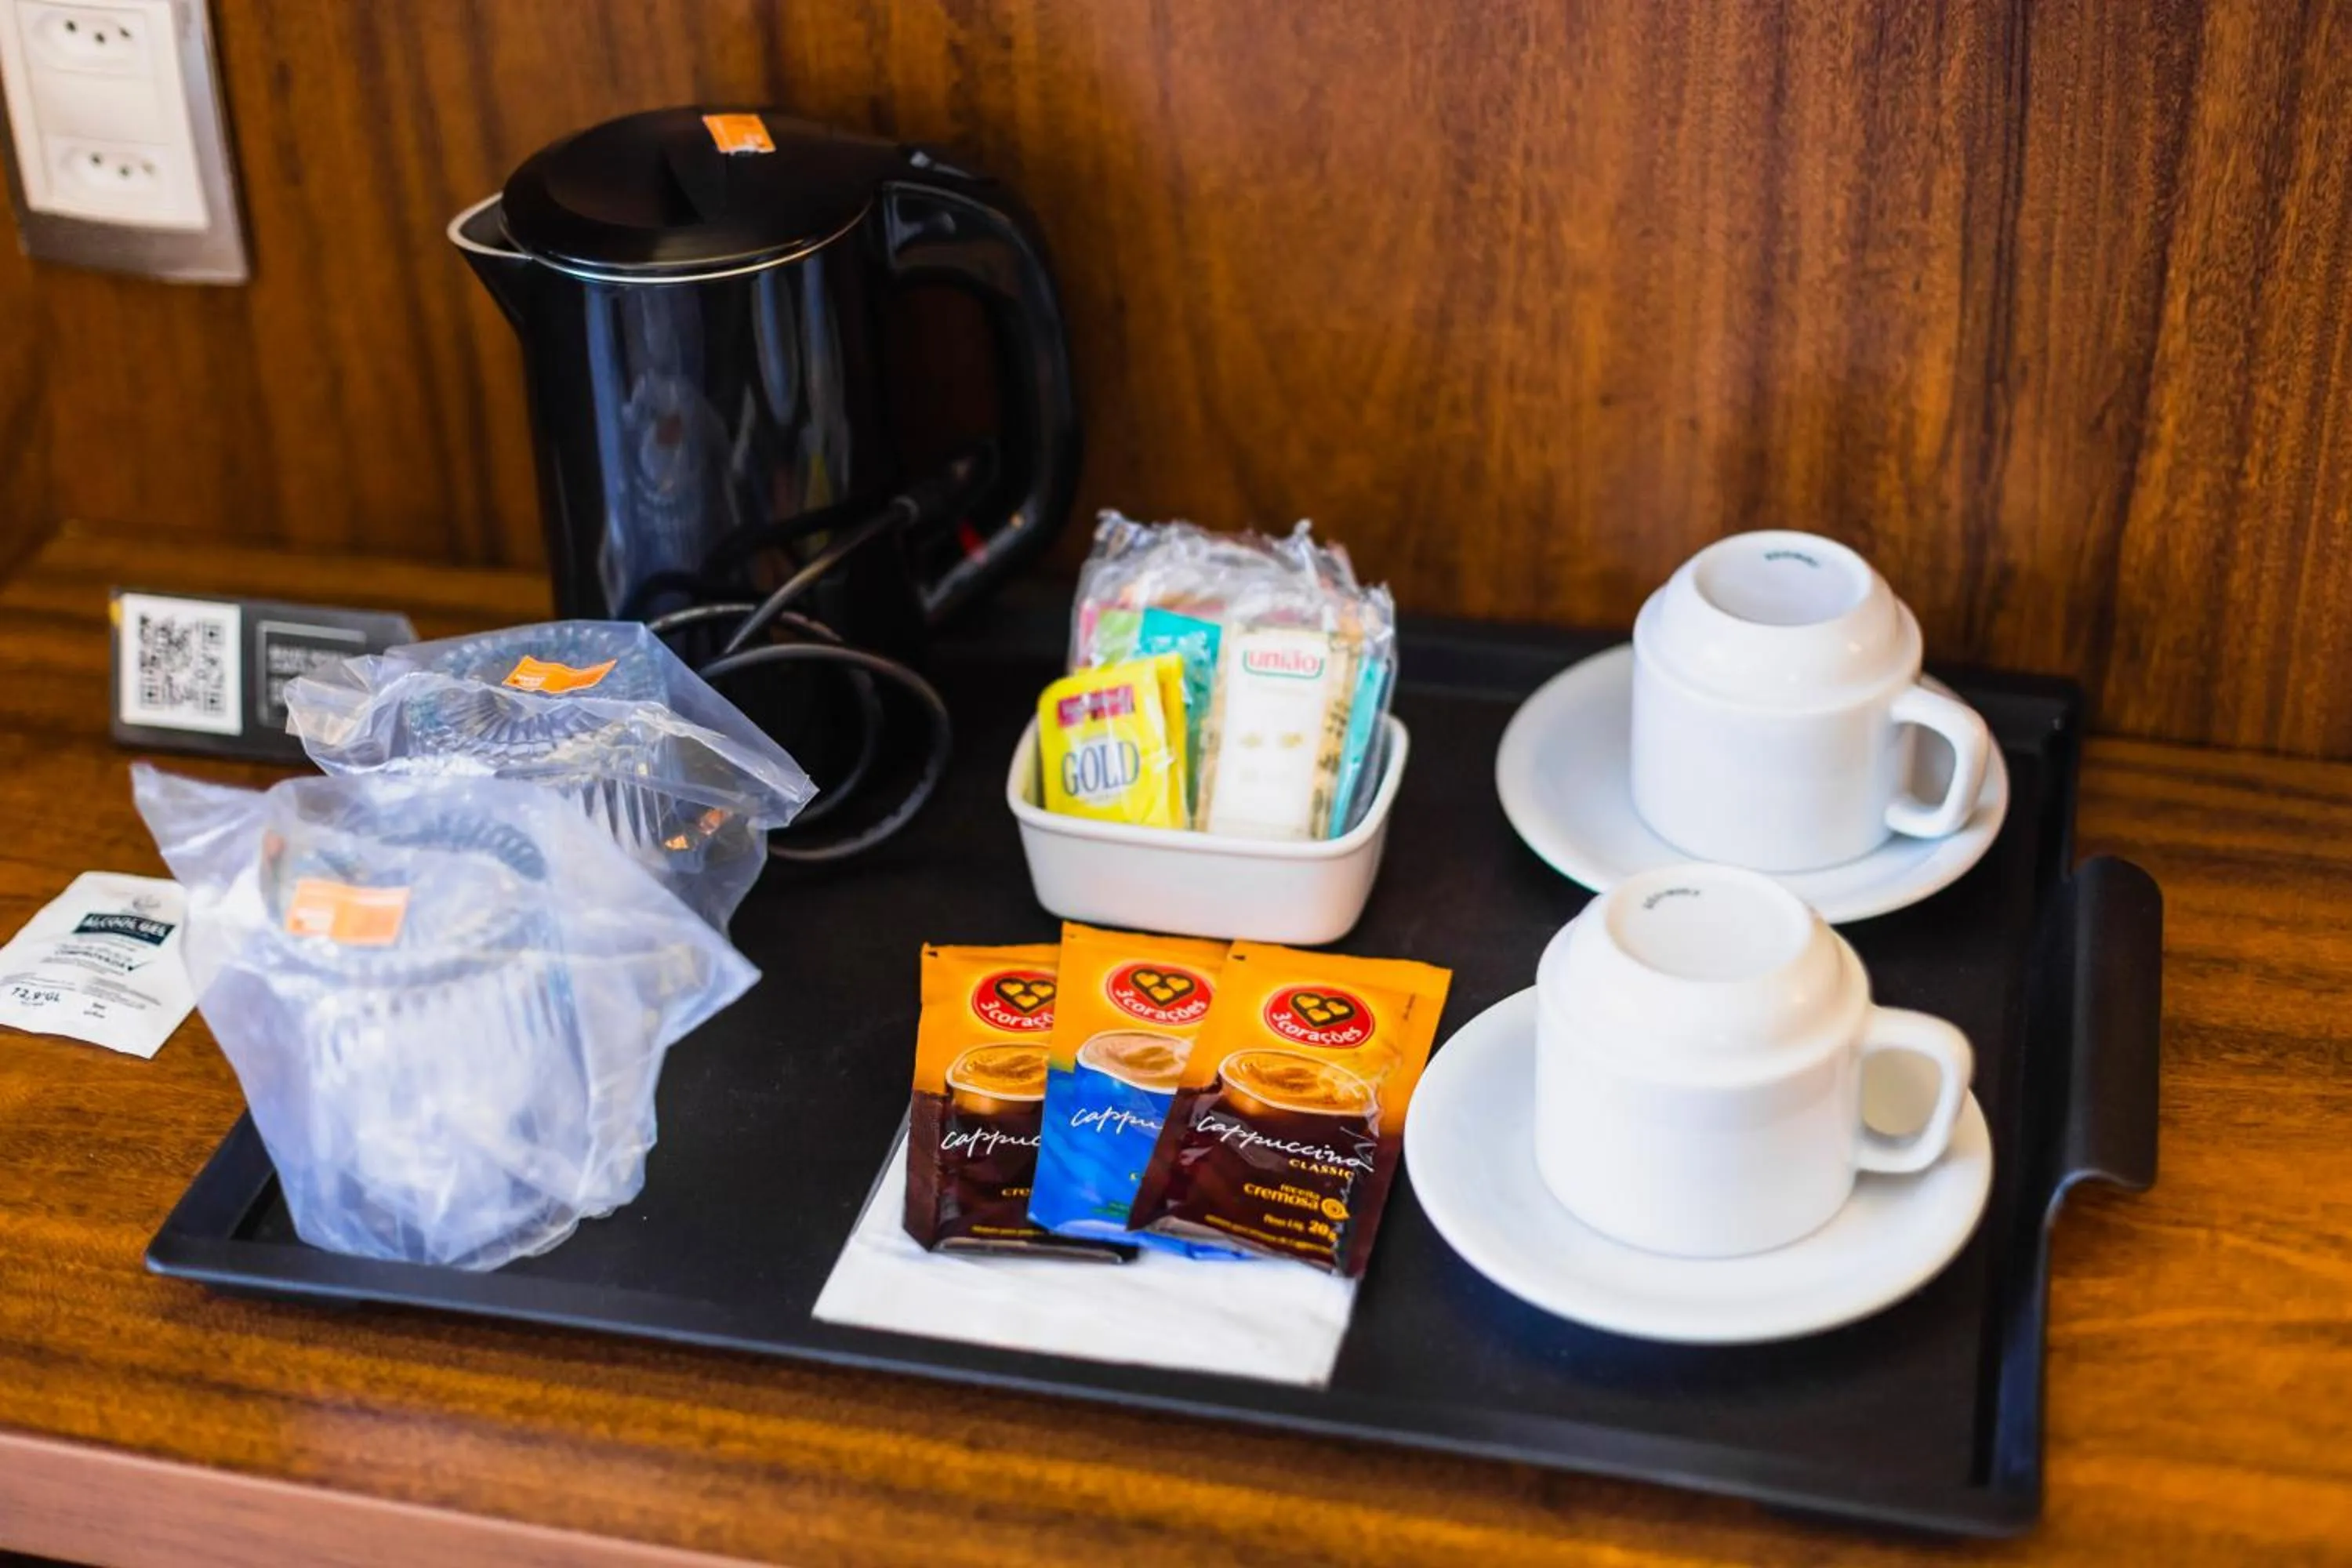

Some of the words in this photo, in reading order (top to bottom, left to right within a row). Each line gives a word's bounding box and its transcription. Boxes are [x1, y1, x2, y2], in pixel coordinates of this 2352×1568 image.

[1062, 741, 1140, 797] GOLD
[980, 1000, 1054, 1028] 3coraçõ
[1288, 1158, 1355, 1180] CLASSIC
[1243, 1182, 1319, 1210] cremosa
